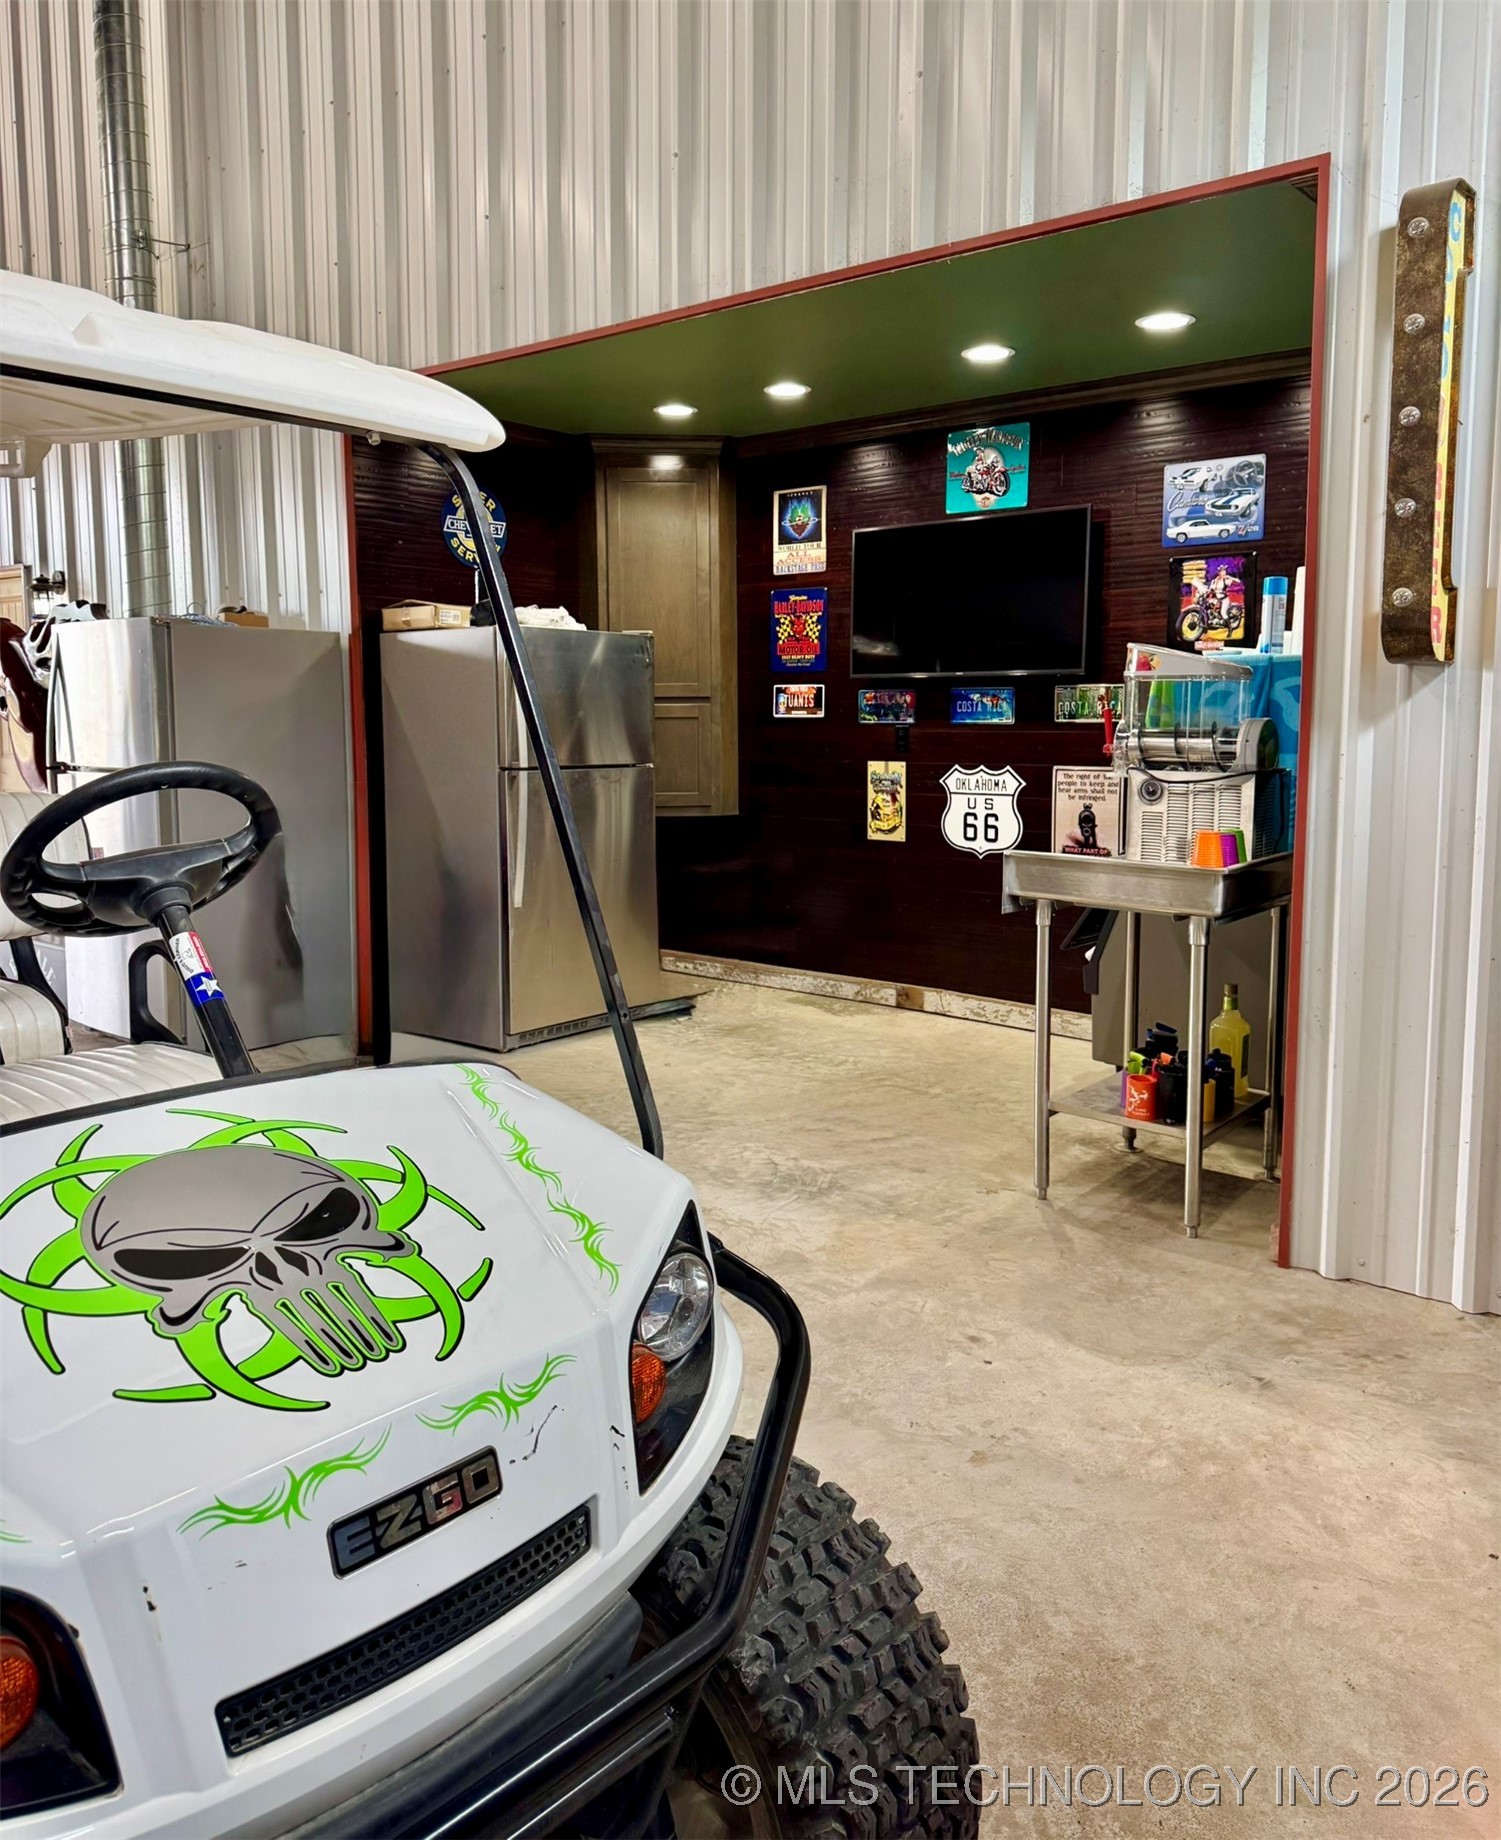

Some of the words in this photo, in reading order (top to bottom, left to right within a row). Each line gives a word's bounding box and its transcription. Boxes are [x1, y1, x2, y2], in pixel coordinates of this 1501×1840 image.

[452, 491, 496, 512] SER
[448, 519, 503, 535] CHEET
[774, 599, 824, 614] HARLEY-DAVIDSON
[780, 645, 804, 654] MOTOR
[806, 645, 818, 654] OIL
[956, 700, 982, 713] COSTA
[987, 700, 1008, 713] RICA
[1058, 701, 1089, 715] COSTA
[955, 777, 1008, 792] OKLAHOMA
[1076, 773, 1091, 781] right
[1089, 780, 1105, 788] keep
[963, 812, 999, 843] 66
[334, 1454, 500, 1570] EZGO
